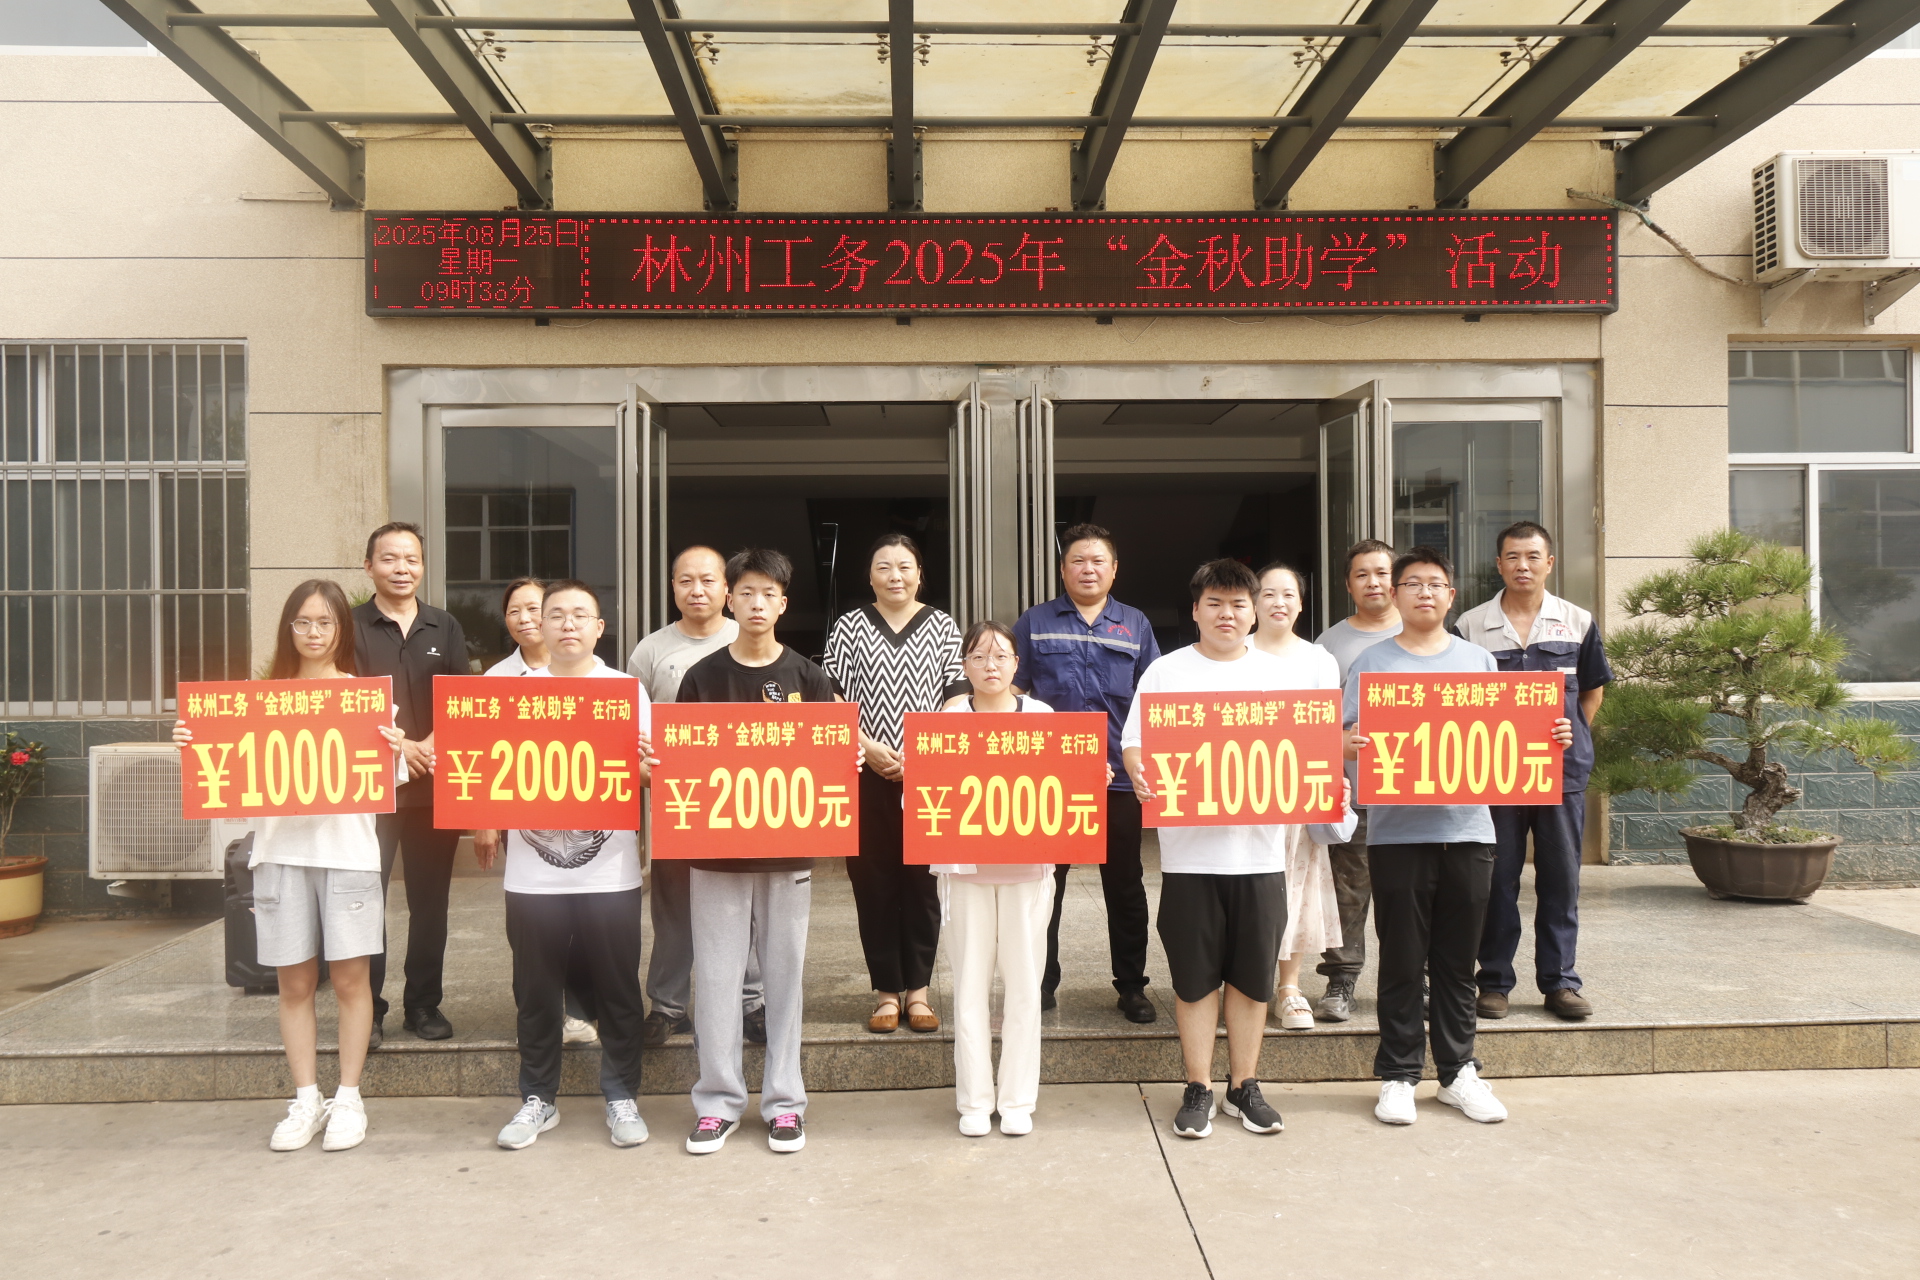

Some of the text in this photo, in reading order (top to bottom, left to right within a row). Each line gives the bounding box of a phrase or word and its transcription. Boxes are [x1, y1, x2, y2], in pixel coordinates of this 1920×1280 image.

[377, 218, 578, 247] 2025年08月25日
[438, 248, 518, 275] 星期一
[421, 276, 535, 303] 09时36分
